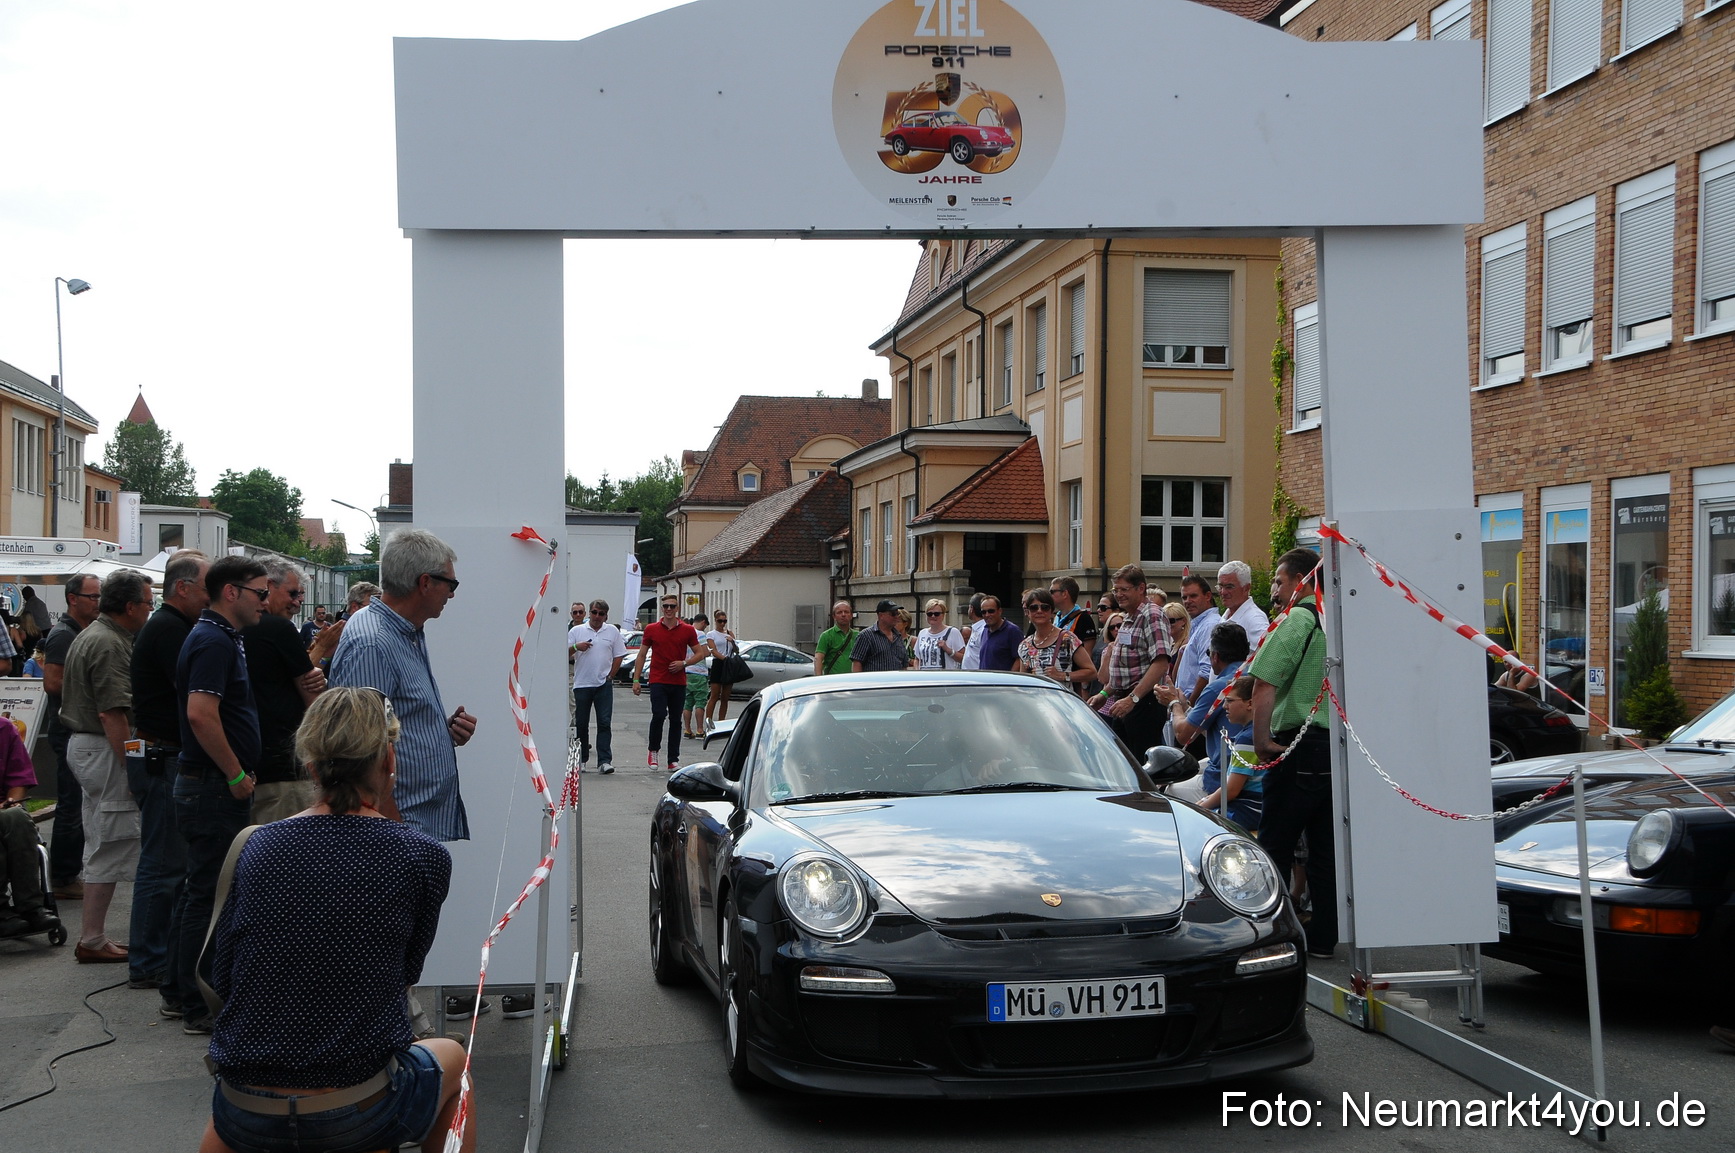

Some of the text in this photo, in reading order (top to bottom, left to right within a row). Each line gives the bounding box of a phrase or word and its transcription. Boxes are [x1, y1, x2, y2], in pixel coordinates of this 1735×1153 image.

[914, 0, 984, 37] ZIEL
[884, 45, 1012, 57] PORSCHE
[932, 57, 965, 68] 911
[918, 176, 982, 184] JAHRE
[993, 981, 1163, 1016] D Mü VH 911
